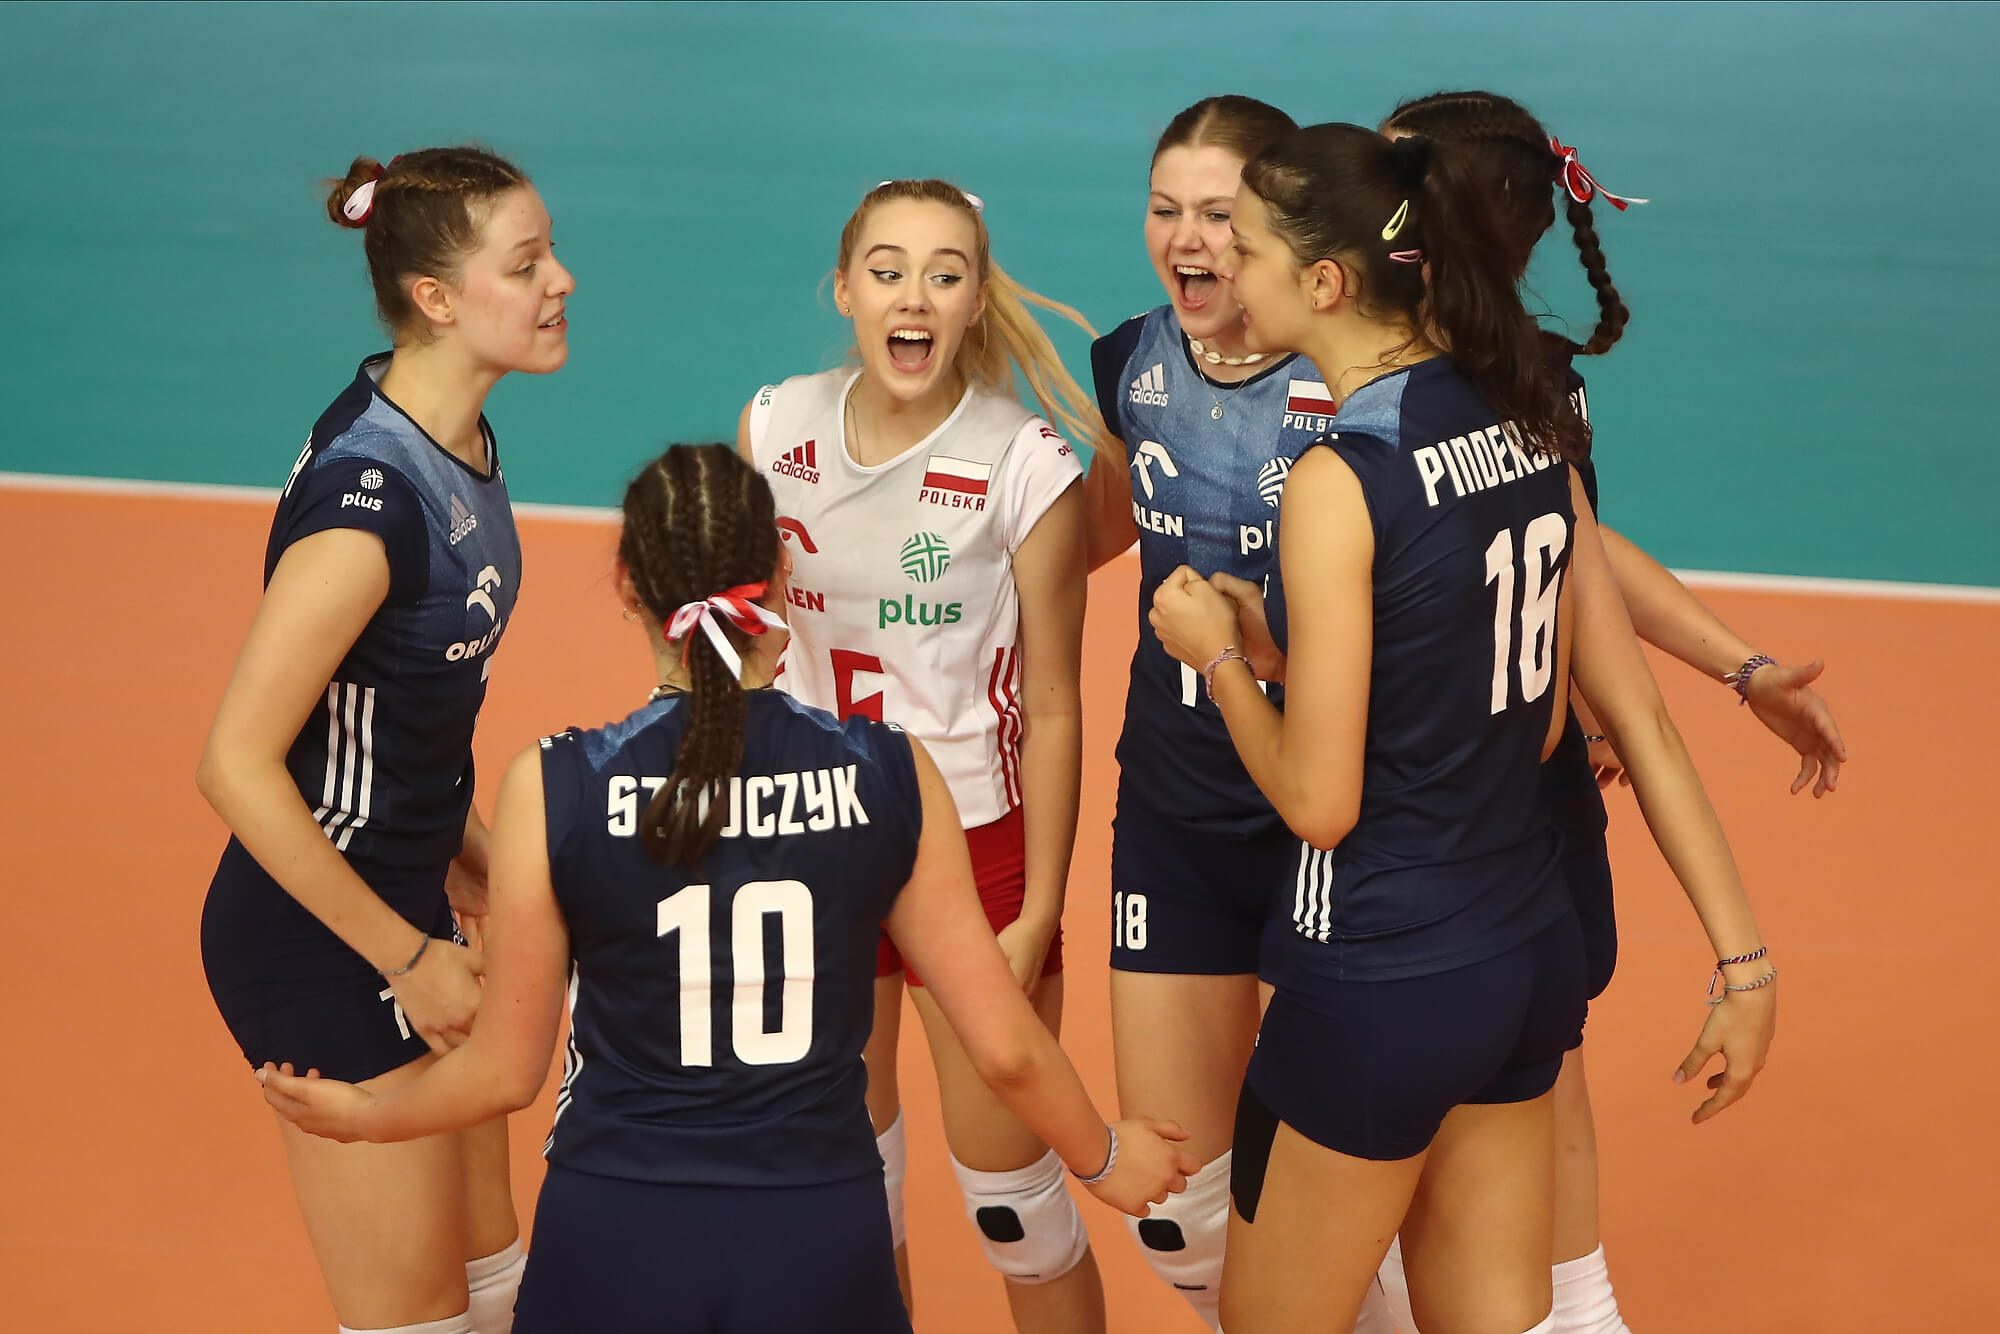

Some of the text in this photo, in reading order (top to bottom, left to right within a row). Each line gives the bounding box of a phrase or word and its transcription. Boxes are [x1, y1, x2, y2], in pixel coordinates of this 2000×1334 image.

[772, 460, 820, 484] adidas
[341, 491, 384, 512] plus
[919, 489, 986, 512] POLSKA
[1132, 498, 1184, 537] RLEN
[450, 514, 477, 545] adidas
[1240, 520, 1273, 556] pl
[784, 583, 825, 612] LEN
[879, 593, 963, 629] plus
[1485, 512, 1567, 714] 16
[1114, 890, 1148, 950] 18
[657, 880, 814, 1067] 10
